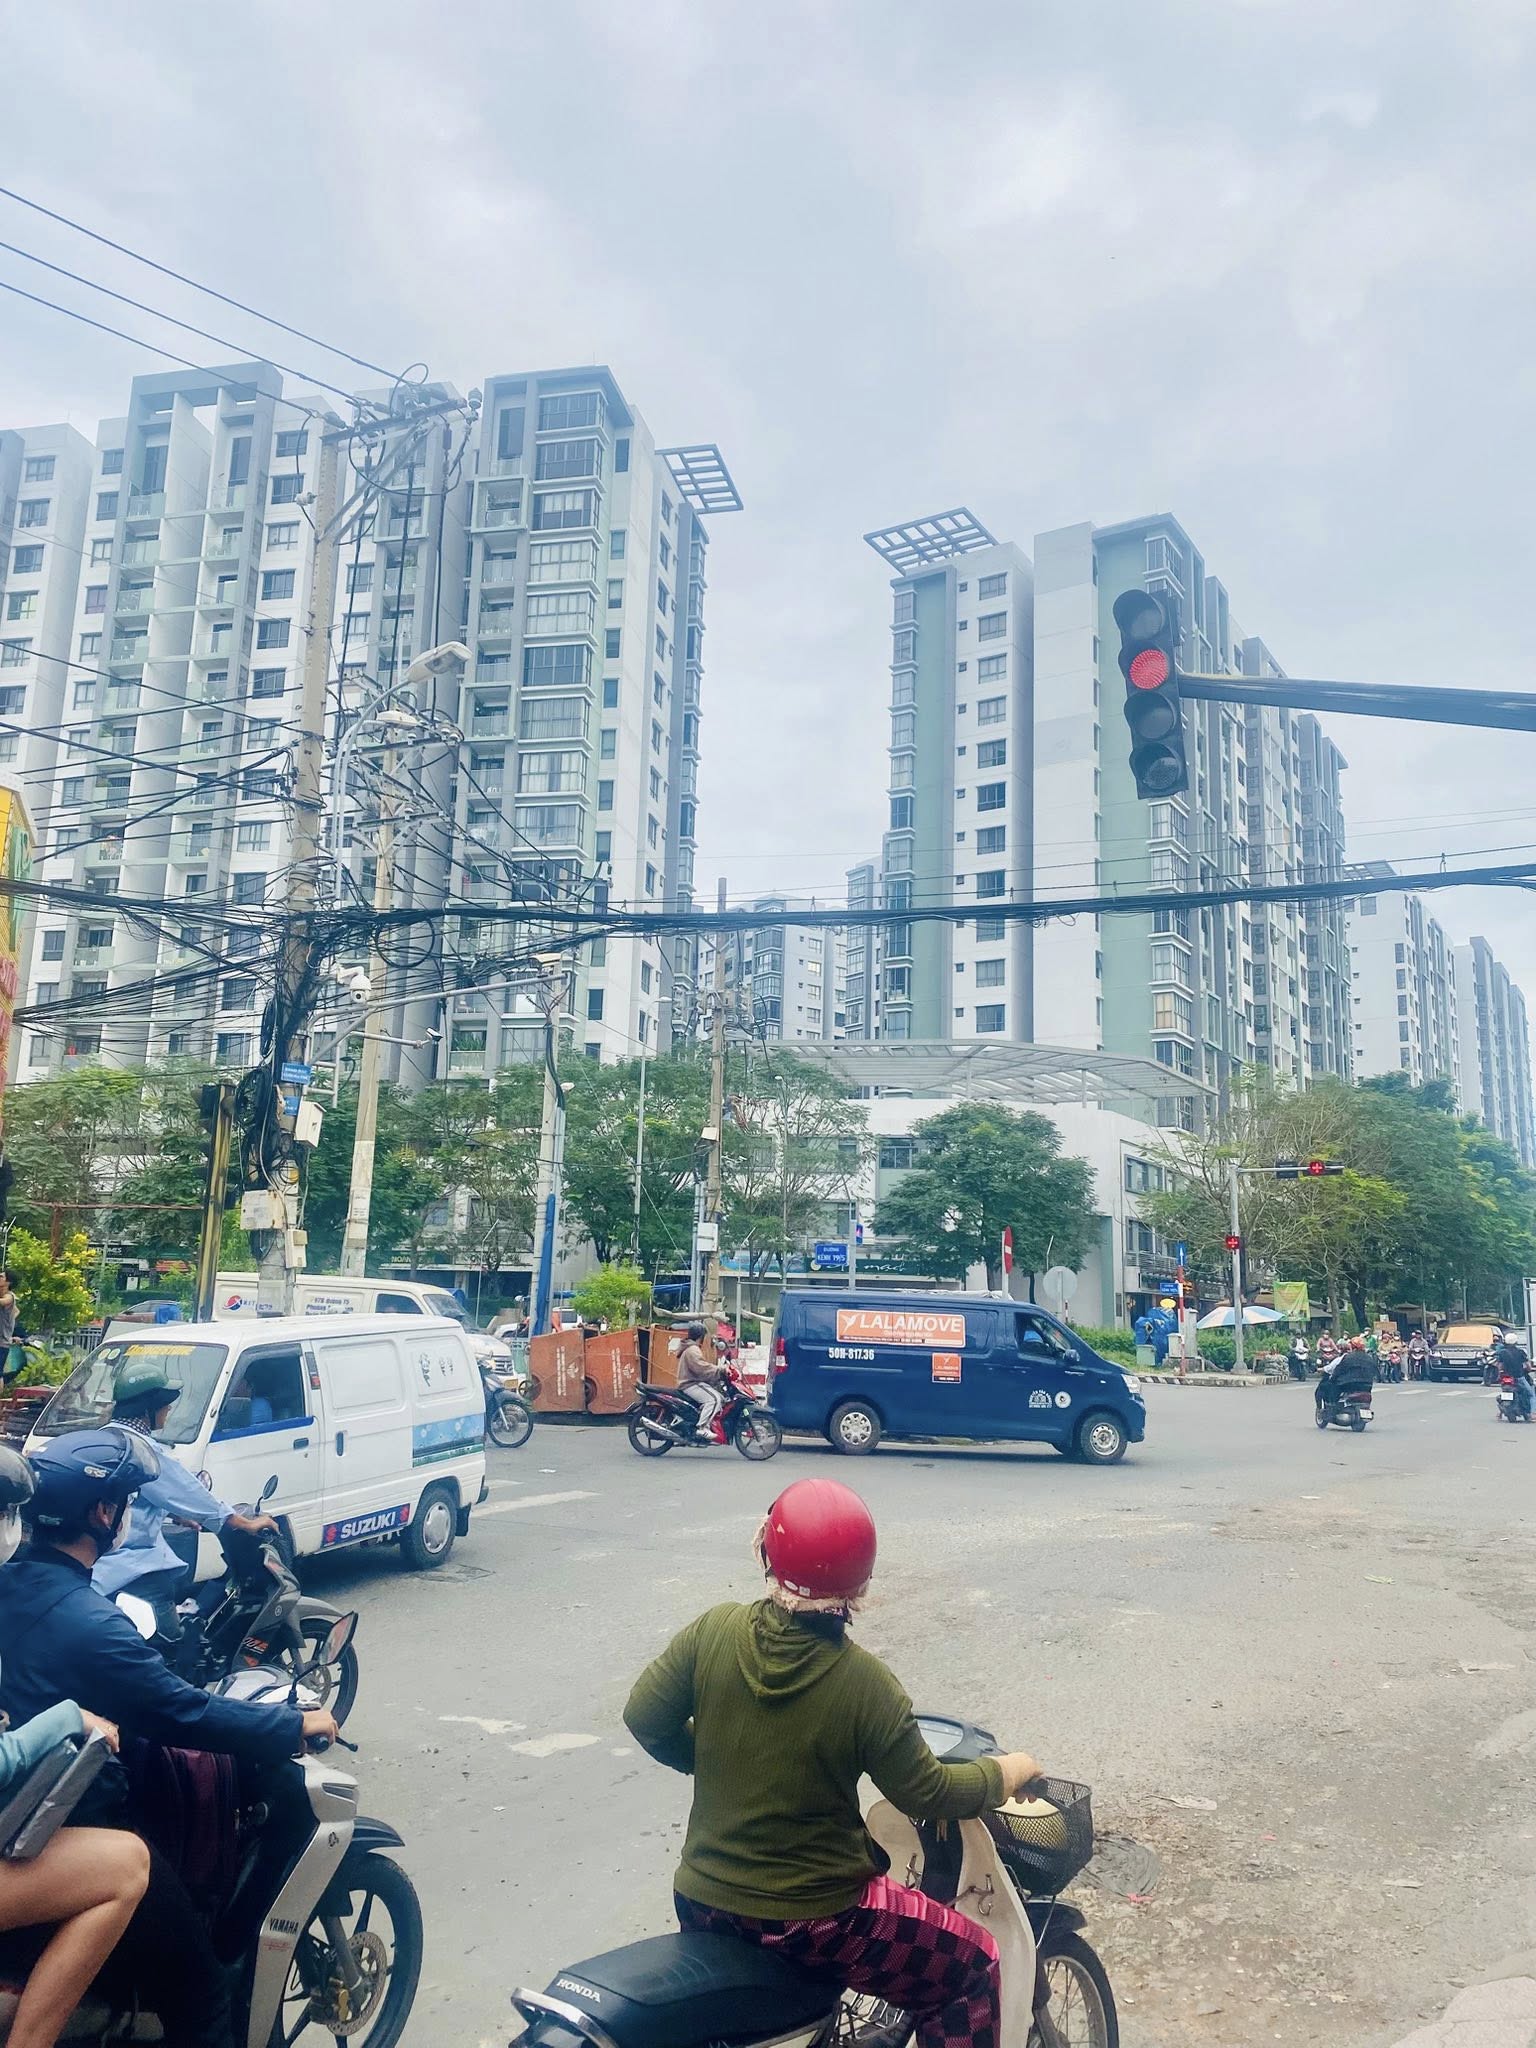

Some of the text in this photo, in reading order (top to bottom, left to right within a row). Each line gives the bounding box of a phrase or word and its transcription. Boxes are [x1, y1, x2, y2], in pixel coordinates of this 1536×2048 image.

[859, 1313, 961, 1333] LALAMOVE
[828, 1347, 875, 1360] 50H-817.36
[340, 1511, 396, 1539] SUZUKI
[269, 1917, 299, 1935] YAMAHA
[556, 1978, 601, 2003] HONDA
